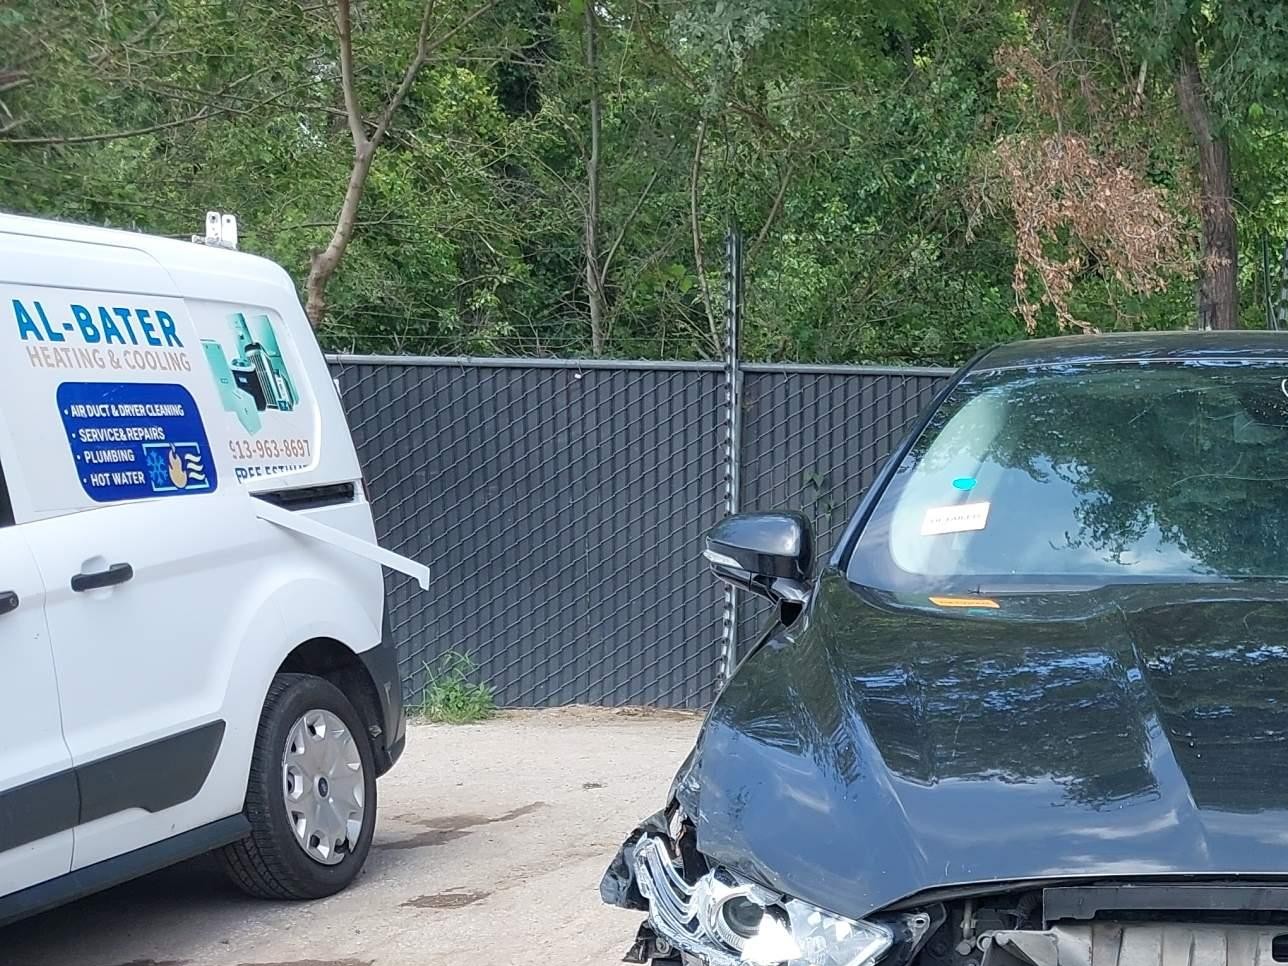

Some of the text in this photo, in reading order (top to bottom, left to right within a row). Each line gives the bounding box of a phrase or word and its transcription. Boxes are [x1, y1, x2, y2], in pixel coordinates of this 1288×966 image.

[12, 299, 185, 348] AL-BATER
[26, 345, 192, 372] HEATING & COOLING
[70, 404, 185, 418] AIR DUCT & DRYER CLEANING
[83, 449, 136, 463] PLUMBING
[90, 471, 146, 487] HOT WATER
